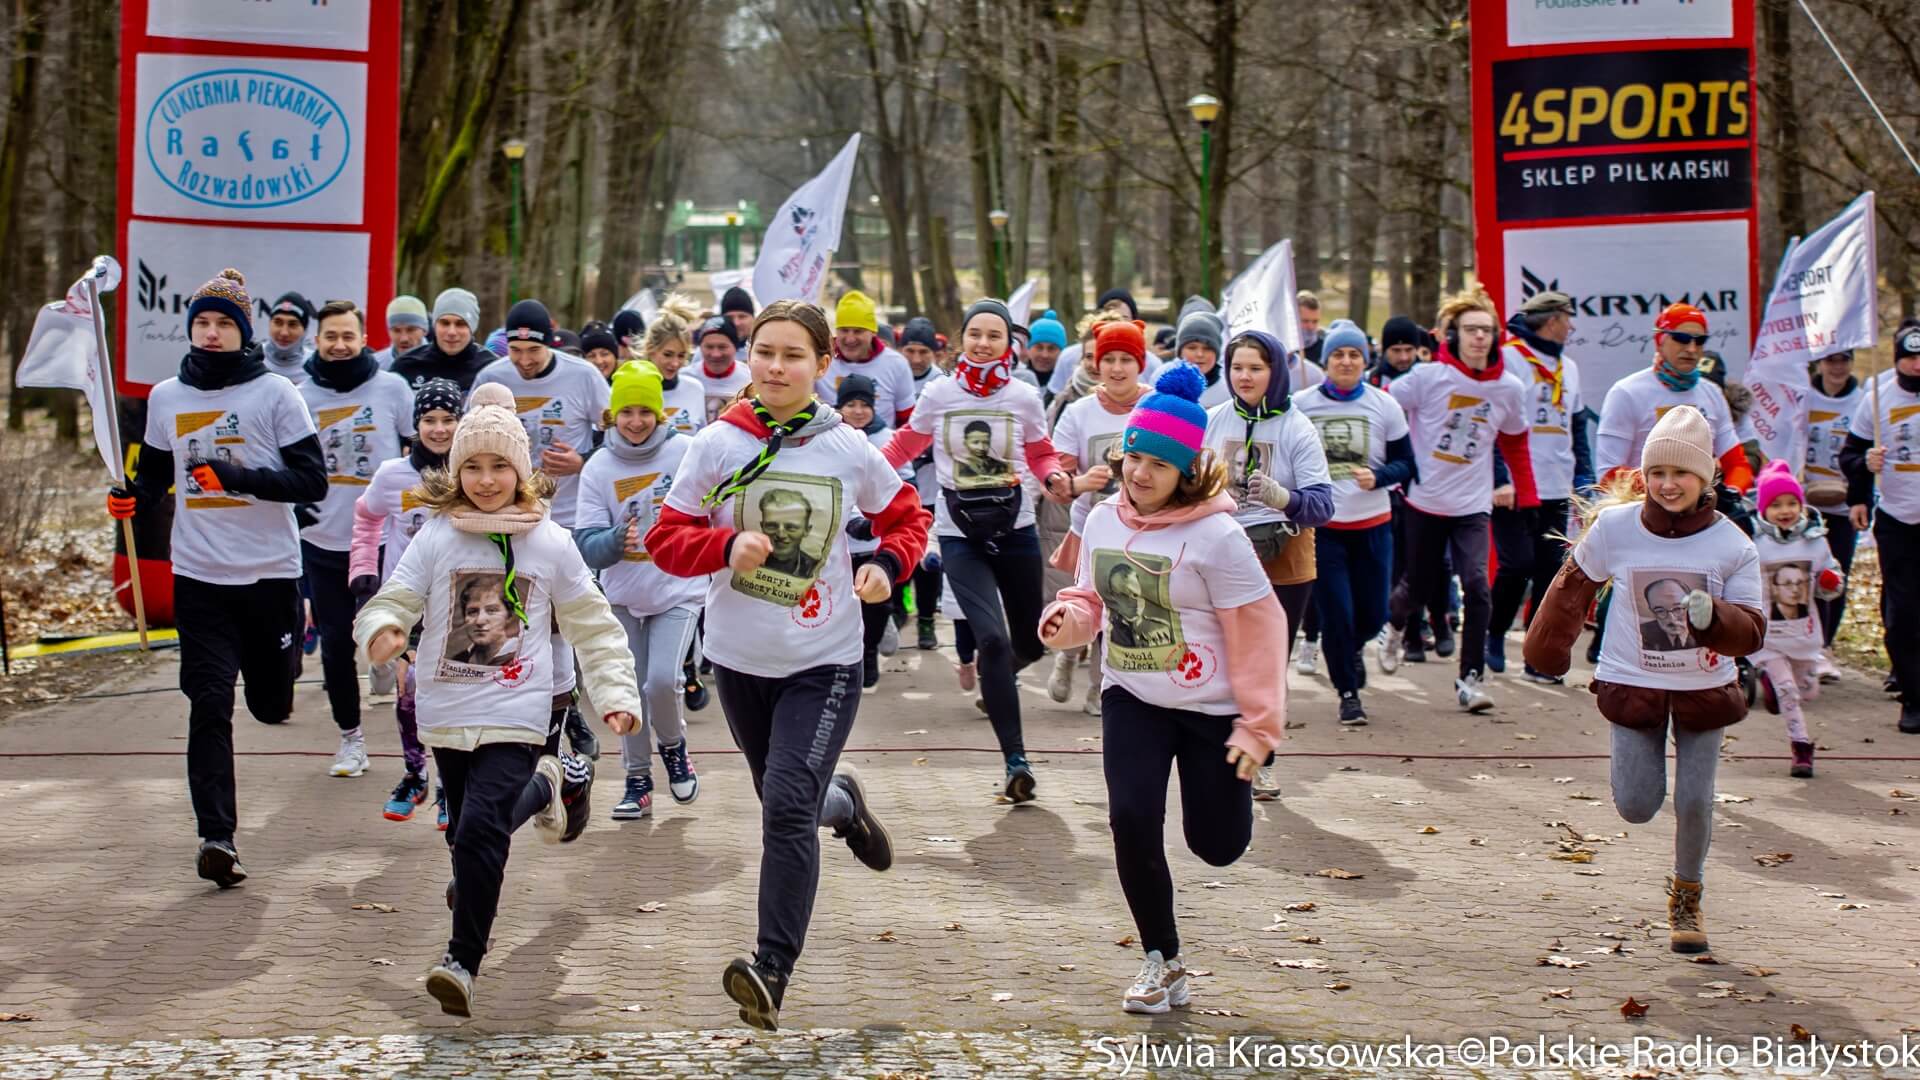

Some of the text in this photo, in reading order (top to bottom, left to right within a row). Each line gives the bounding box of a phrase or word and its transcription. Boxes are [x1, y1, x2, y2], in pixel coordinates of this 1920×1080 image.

[161, 78, 333, 130] CUKIERNIA PIEKARNIA
[1499, 80, 1748, 147] 4SPORTS
[176, 159, 314, 201] Rozwadowski
[1521, 159, 1730, 189] SKLEP PIŁKARSKI
[755, 569, 792, 588] Henryk
[1122, 660, 1160, 670] Pilecki
[805, 707, 838, 770] AROUND
